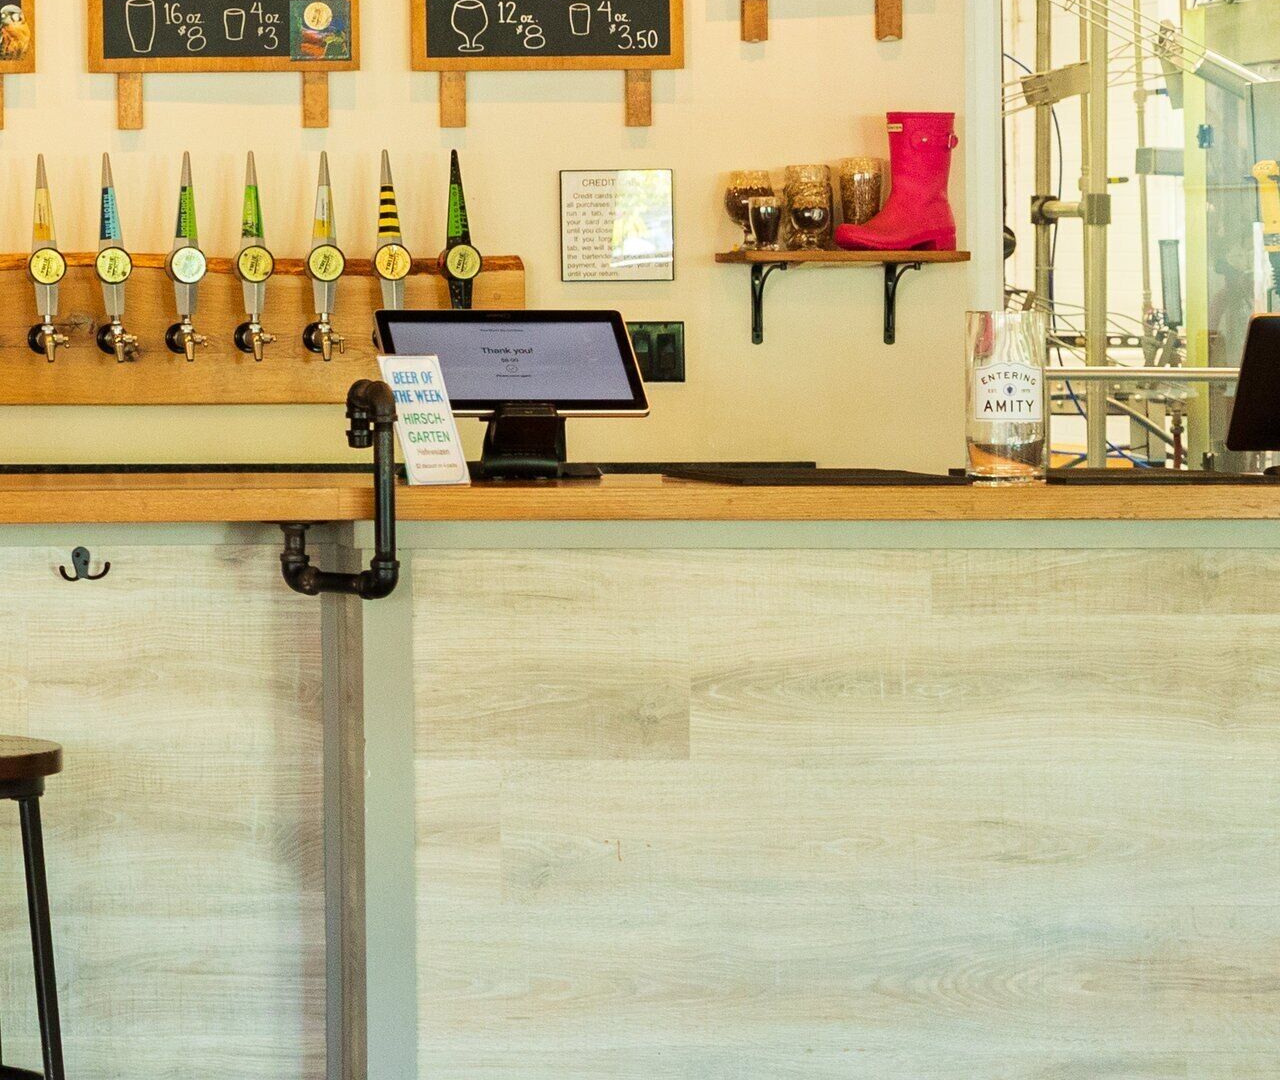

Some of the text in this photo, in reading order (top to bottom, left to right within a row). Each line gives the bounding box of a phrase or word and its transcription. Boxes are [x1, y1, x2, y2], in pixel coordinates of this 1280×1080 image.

[513, 347, 533, 355] you!
[392, 371, 432, 383] BEER OF
[981, 371, 1037, 386] ENTERING
[415, 390, 443, 403] WEEK
[984, 400, 1034, 413] AMITY
[403, 413, 445, 424] HIRSCH-
[408, 432, 450, 443] GARTEN
